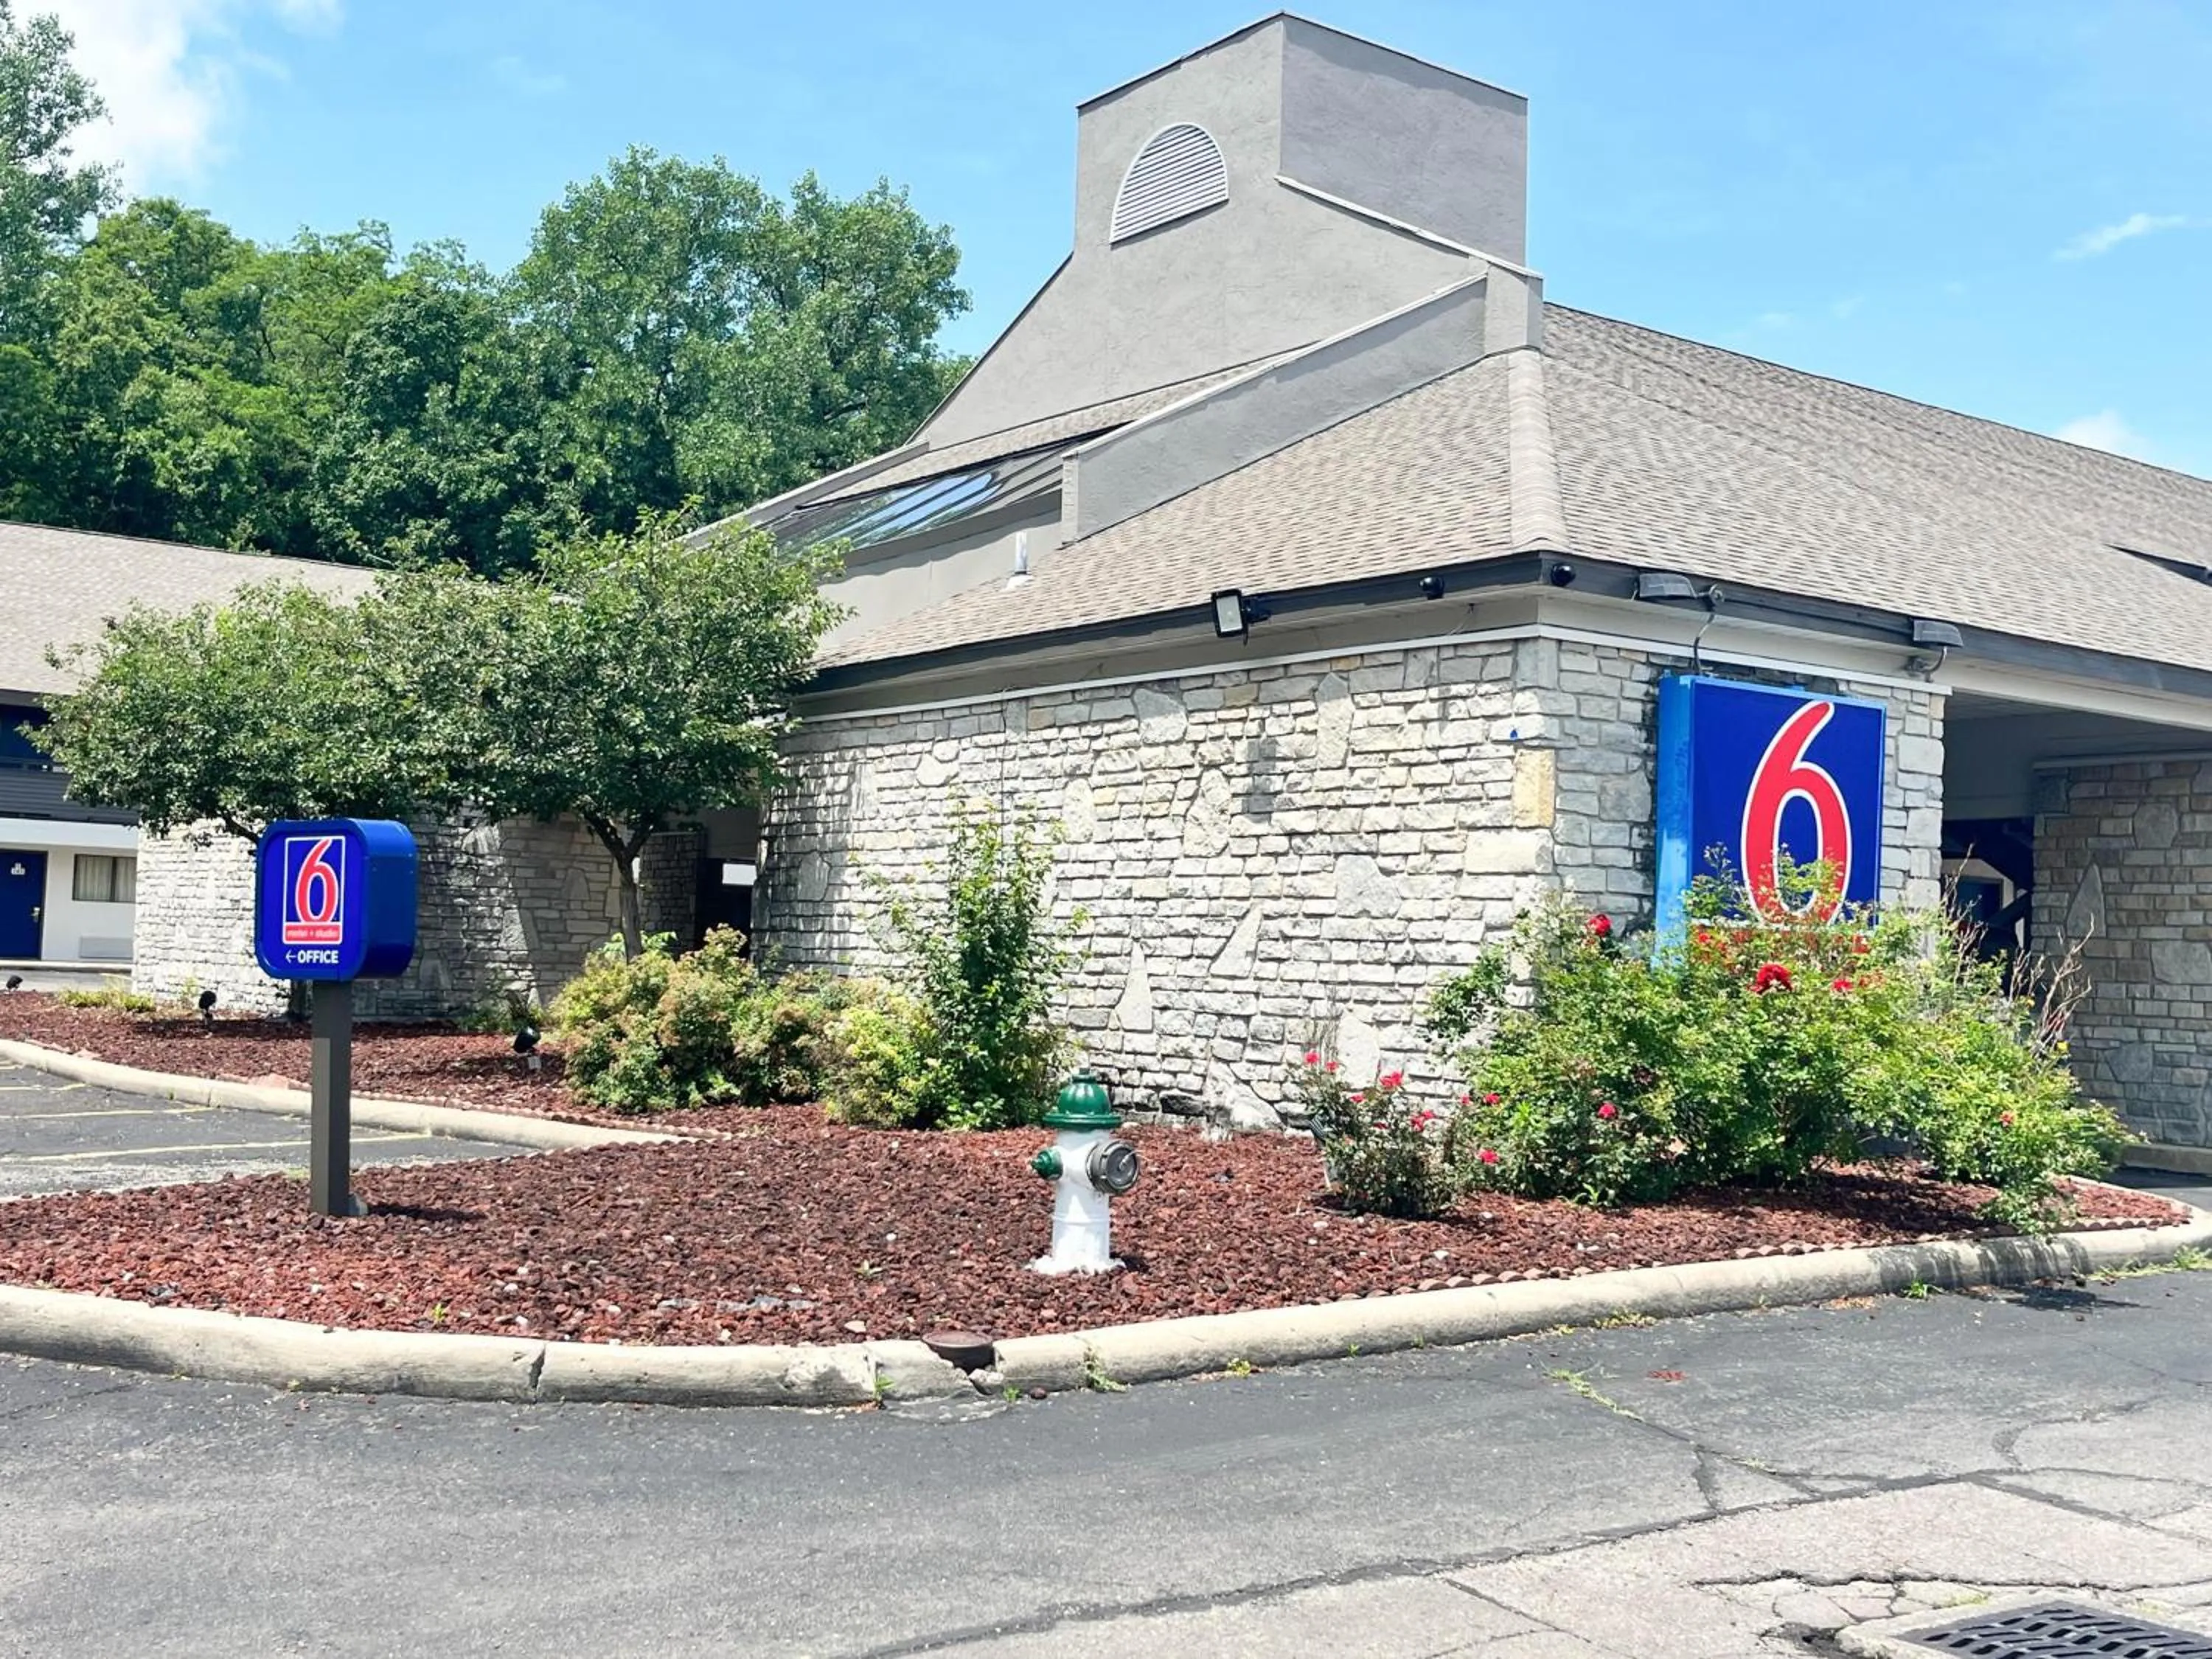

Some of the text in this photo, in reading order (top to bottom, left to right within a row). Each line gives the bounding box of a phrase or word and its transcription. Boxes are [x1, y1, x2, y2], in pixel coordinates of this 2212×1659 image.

[1740, 700, 1853, 928] 6
[295, 836, 339, 922] 6
[297, 949, 339, 964] OFFICE
